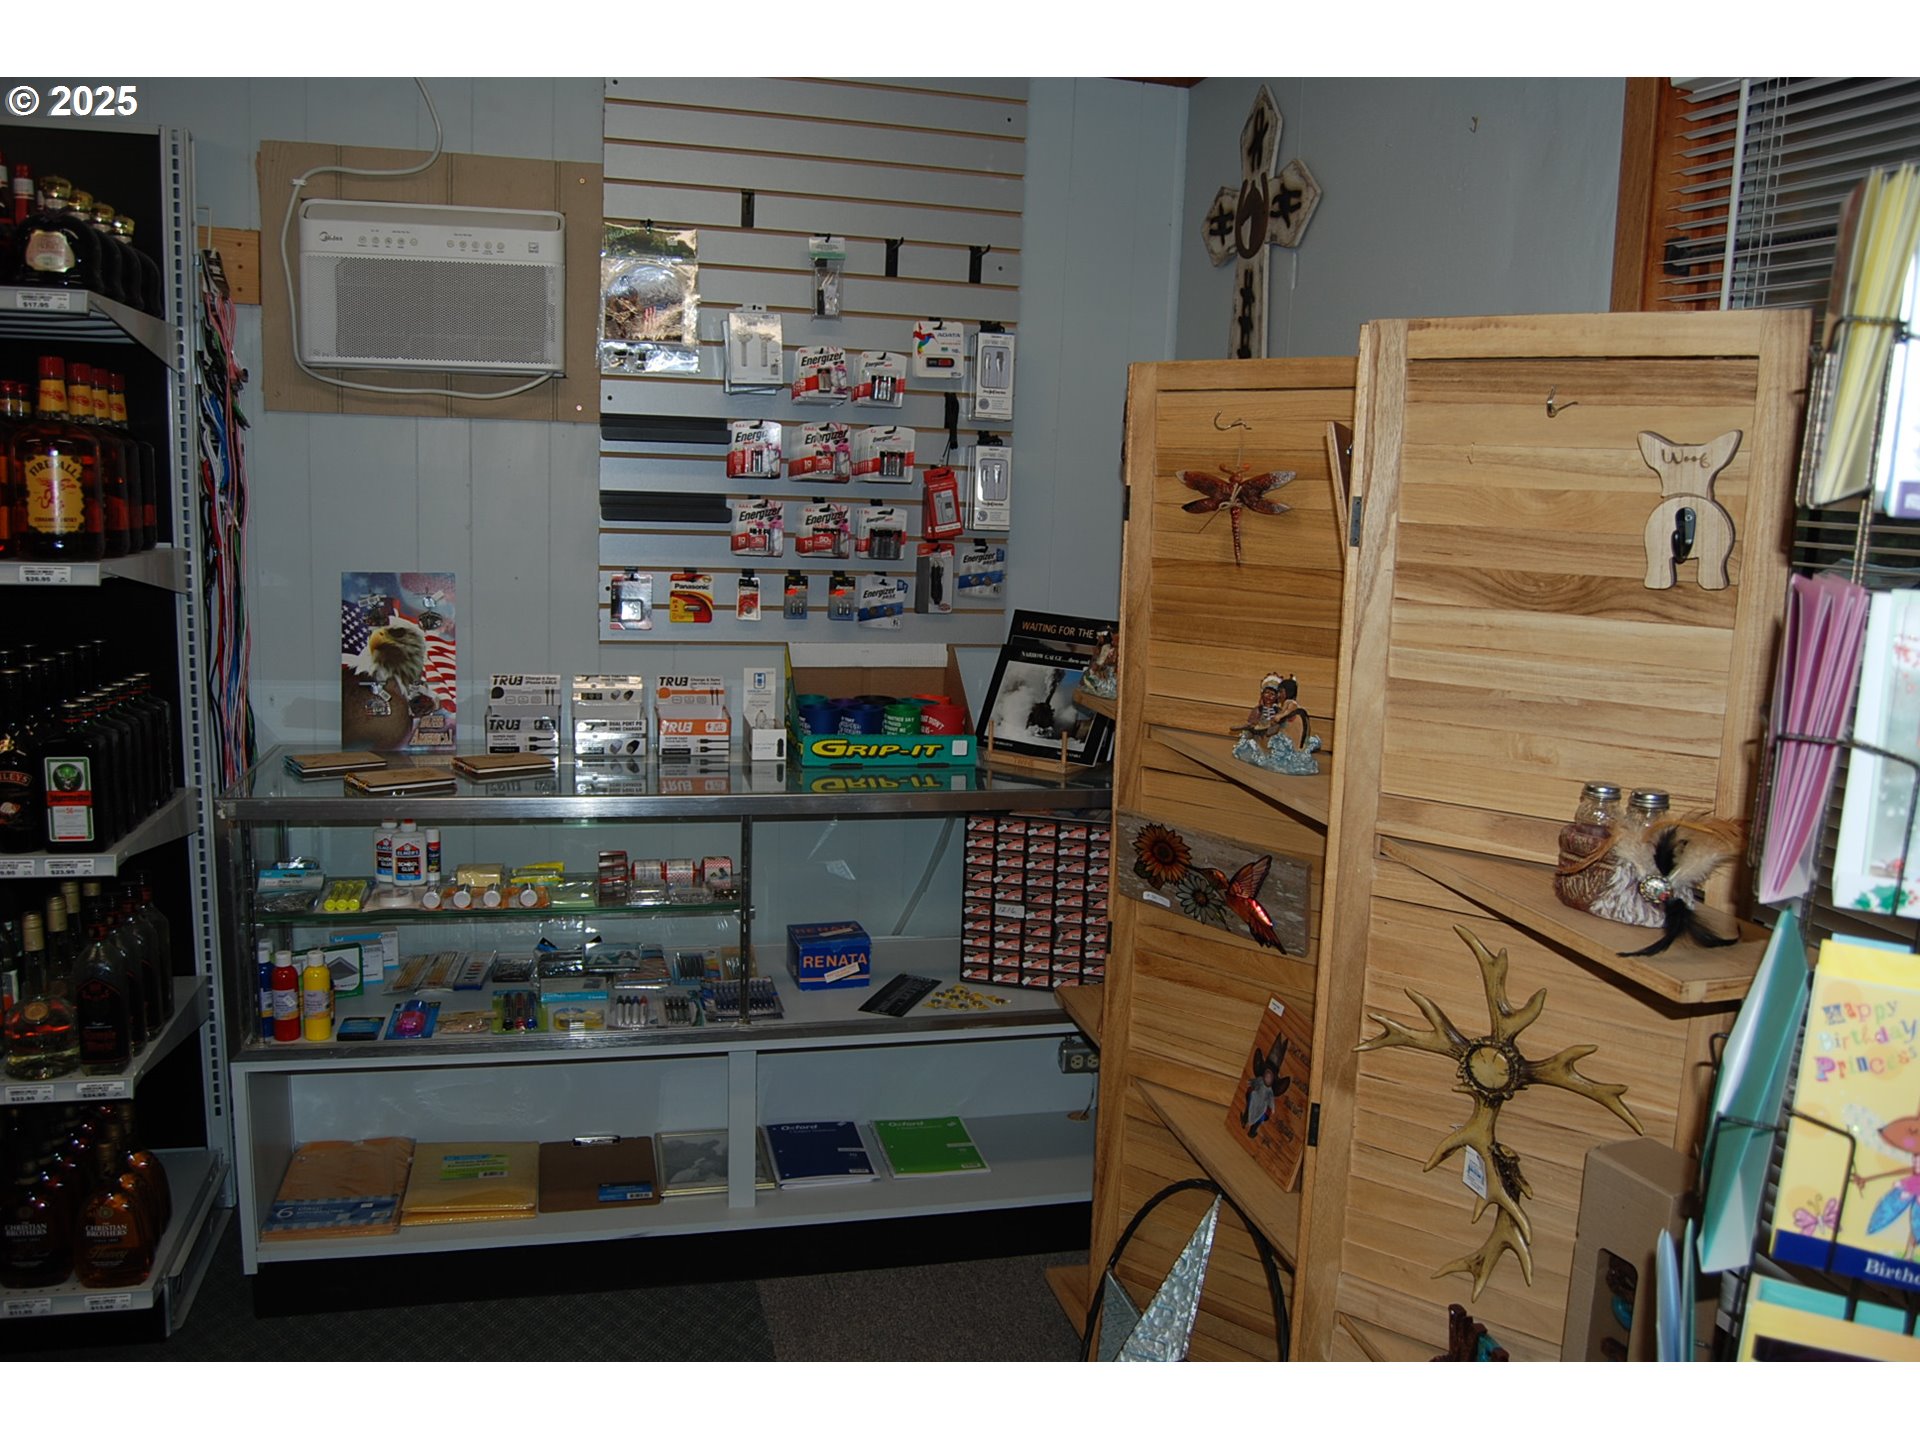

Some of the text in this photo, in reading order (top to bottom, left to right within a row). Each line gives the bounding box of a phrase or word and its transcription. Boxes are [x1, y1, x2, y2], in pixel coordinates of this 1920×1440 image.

[800, 351, 844, 367] Energizer
[864, 360, 886, 368] Energizer
[738, 506, 782, 522] Energizer
[805, 510, 848, 525] Energizer
[866, 515, 886, 523] Energizer
[963, 551, 996, 563] Energizer
[862, 587, 896, 599] Energizer
[1021, 620, 1095, 639] WAITING FOR THE
[492, 675, 523, 686] TRUE
[659, 677, 689, 687] TRUE
[488, 719, 521, 731] TRUE
[811, 738, 944, 759] GRIP-IT
[802, 952, 868, 969] RENATA
[1822, 1000, 1898, 1025] Happy
[1817, 1019, 1918, 1052] Birthday
[1813, 1046, 1918, 1083] Princess
[276, 1205, 295, 1218] 6
[5, 1223, 48, 1231] CHRISTIAN
[5, 1229, 48, 1237] BROTHERS
[85, 1223, 128, 1231] CHRISTIAN
[86, 1229, 128, 1237] BROTHERS
